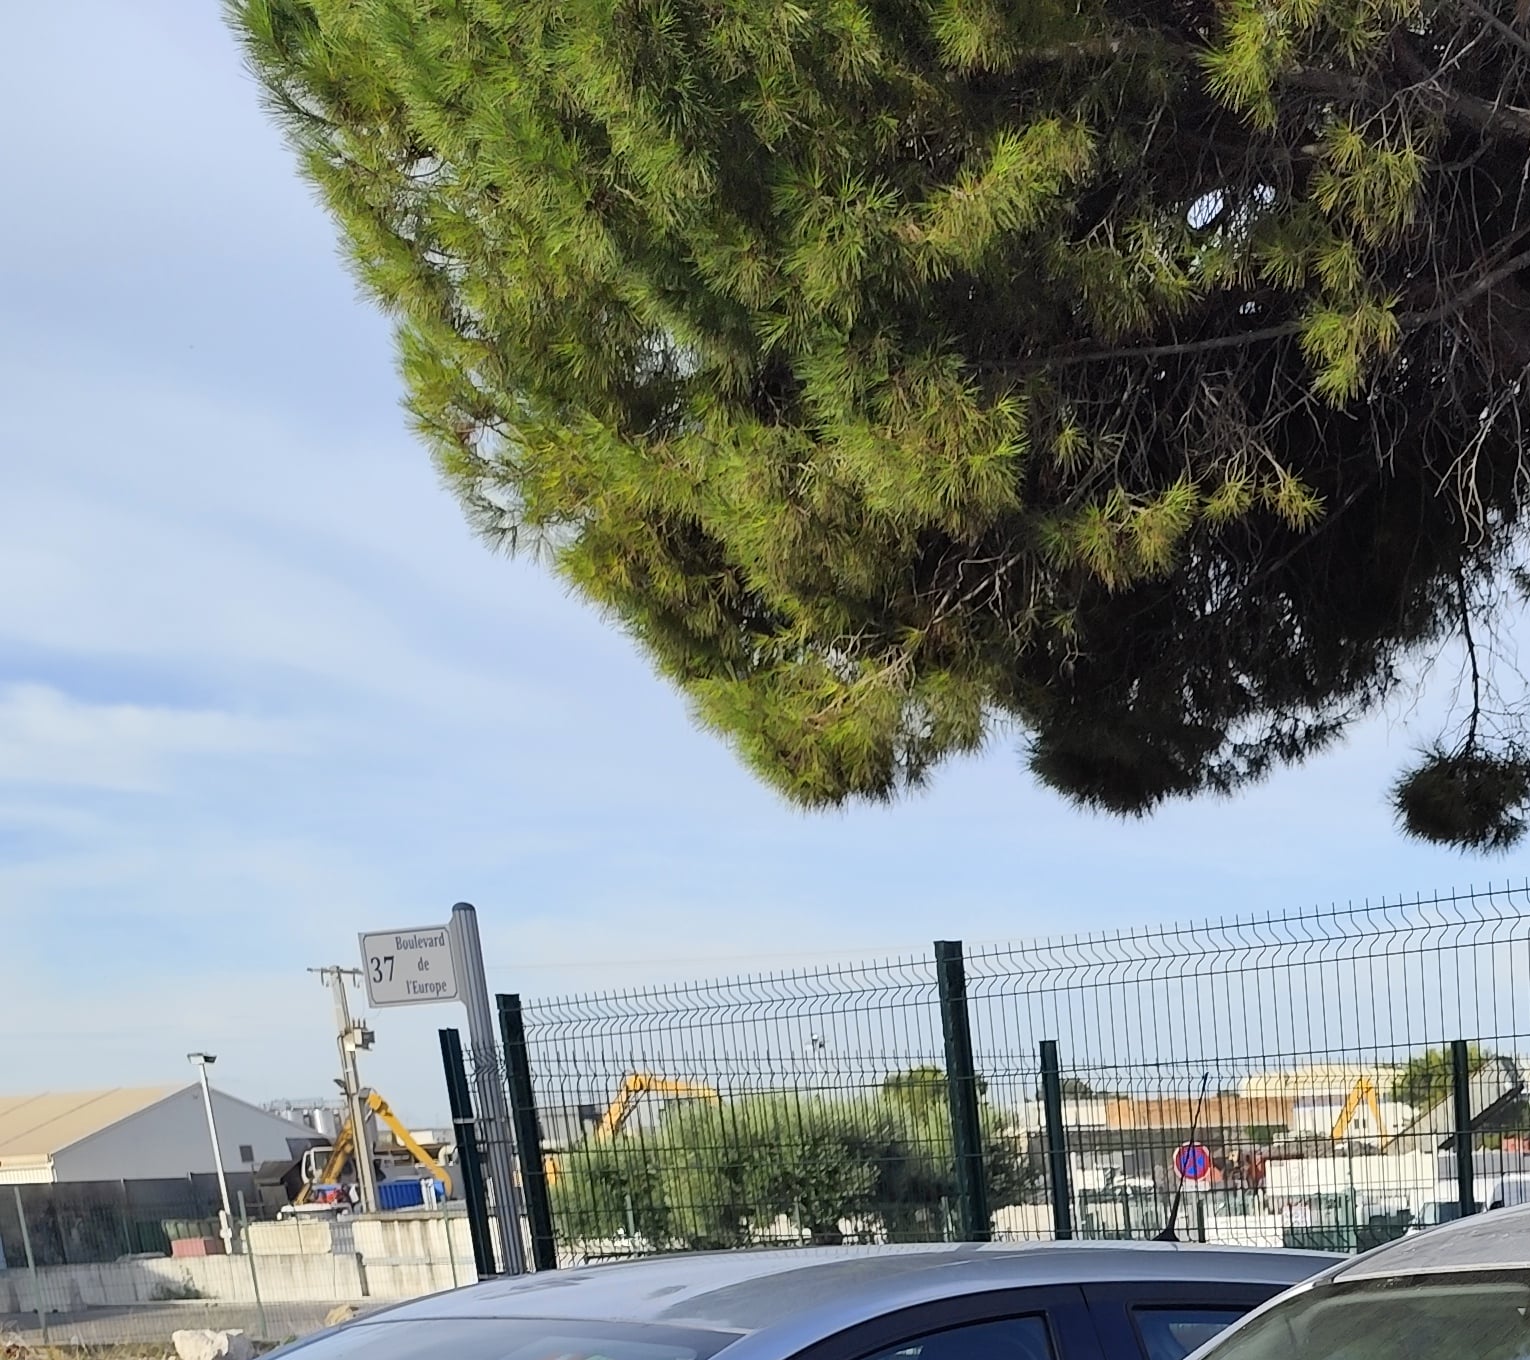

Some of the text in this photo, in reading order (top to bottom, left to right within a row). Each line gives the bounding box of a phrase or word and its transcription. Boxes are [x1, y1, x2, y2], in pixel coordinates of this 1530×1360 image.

[395, 932, 445, 950] Boulevard
[370, 955, 394, 983] 37
[417, 957, 430, 971] de
[406, 979, 447, 996] l'Europe
